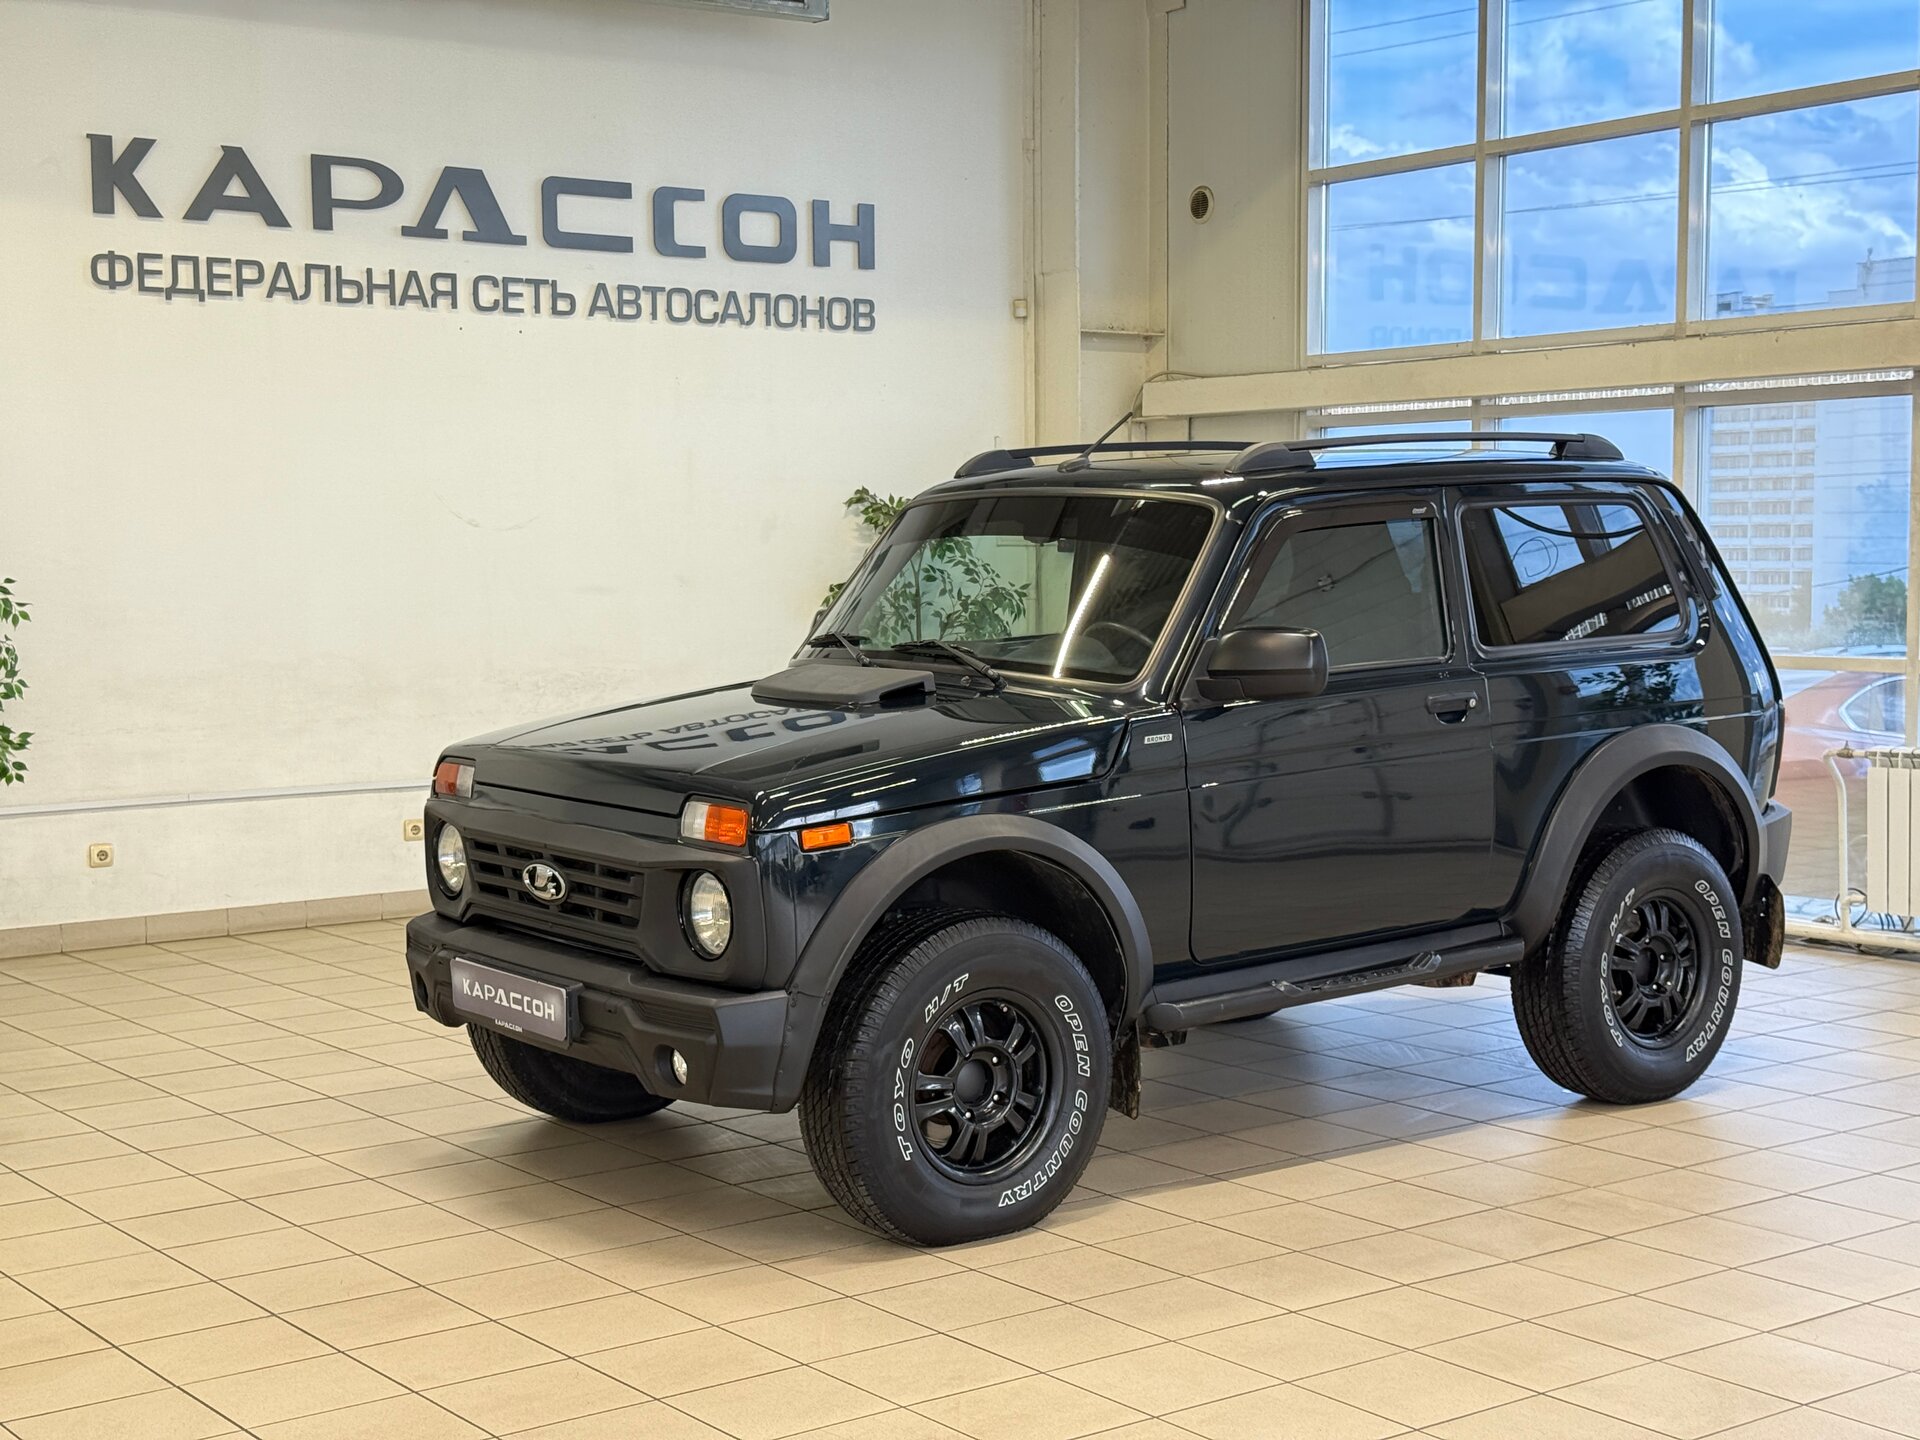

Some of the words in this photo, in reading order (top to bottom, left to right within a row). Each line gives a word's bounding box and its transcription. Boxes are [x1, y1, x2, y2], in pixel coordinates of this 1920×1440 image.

[90, 250, 458, 311] ФЕДЕРАЛЬНАЯ
[472, 274, 576, 317] СЕТЬ
[588, 282, 876, 333] АВТОСАЛОНОВ
[1694, 879, 1732, 939] OPEN
[1054, 994, 1091, 1078] OPEN
[1600, 951, 1623, 1048] TOYO
[1685, 948, 1733, 1063] COUNTRY
[893, 1037, 915, 1162] TOYO
[924, 973, 970, 1024] H/T
[998, 1089, 1088, 1208] COUNTRY
